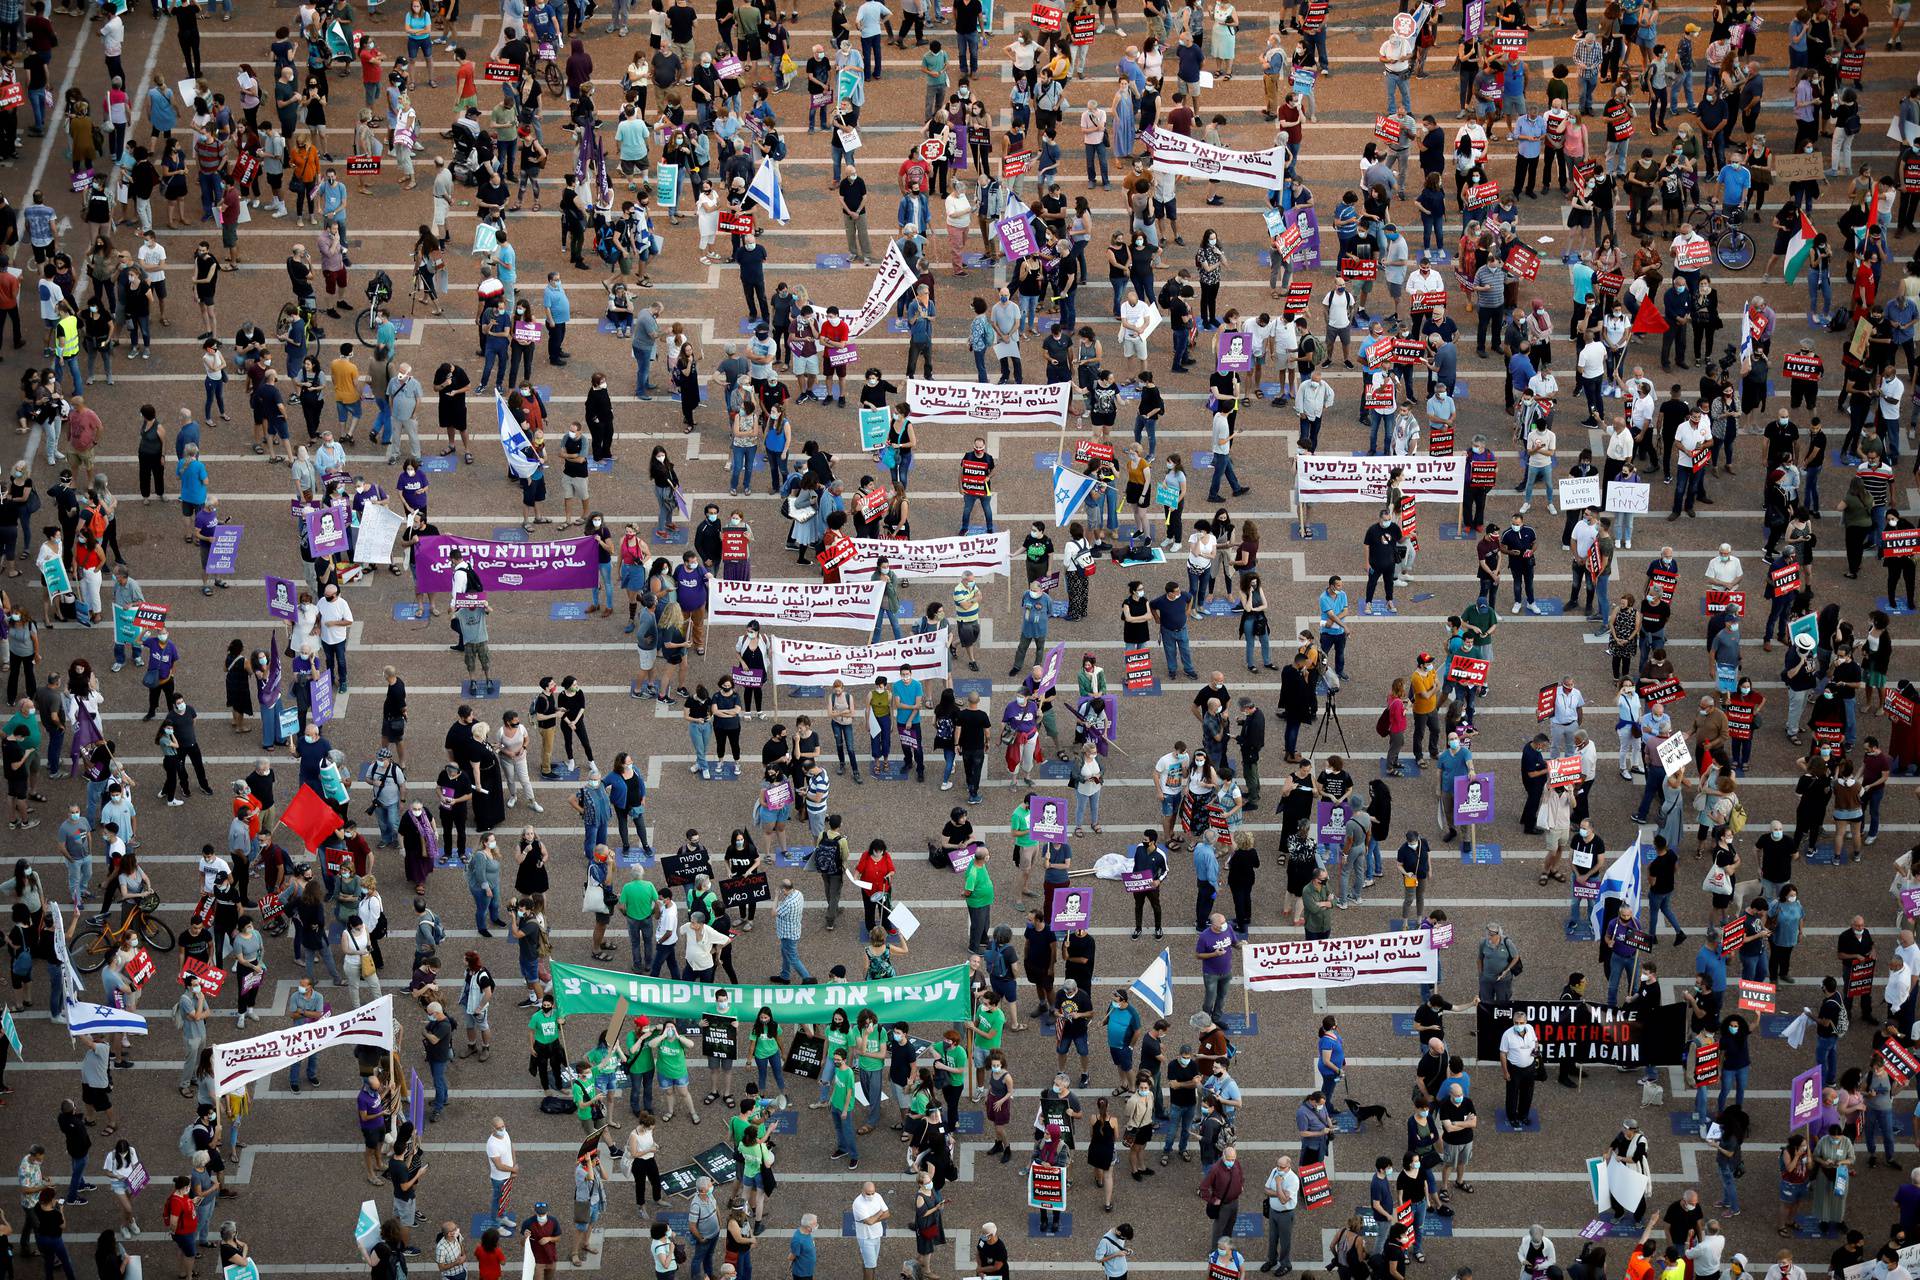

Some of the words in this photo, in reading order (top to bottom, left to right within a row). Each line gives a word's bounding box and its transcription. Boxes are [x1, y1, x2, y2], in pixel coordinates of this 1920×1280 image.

[1468, 194, 1498, 207] APARTHEID
[1679, 257, 1709, 266] APARTHEID
[1787, 356, 1819, 364] Palestinian
[1787, 364, 1816, 373] LIVES
[915, 384, 967, 398] פלסטין
[972, 387, 1018, 399] ישראל
[920, 397, 970, 408] فلسطين
[1304, 461, 1357, 473] פלסטין
[1416, 460, 1456, 473] שלום
[1560, 478, 1598, 486] PALESTINIAN
[864, 502, 889, 519] APARTHEID
[837, 540, 850, 550] לא
[904, 542, 954, 554] ישראל
[959, 538, 999, 551] שלום
[1887, 539, 1917, 548] LIVES
[495, 543, 525, 558] ולא
[532, 543, 576, 557] שלום
[552, 558, 586, 570] سلام
[824, 548, 854, 569] לסיפוח
[478, 560, 506, 570] ضم
[511, 561, 548, 570] وليس
[1776, 574, 1797, 586] LIVES
[724, 594, 778, 606] فلسطين
[783, 595, 833, 608] إسرائيل
[837, 596, 870, 606] سلام
[138, 611, 162, 620] LIVES
[788, 650, 841, 665] فلسطين
[846, 648, 896, 661] إسرائيل
[901, 646, 935, 658] سلام
[1473, 662, 1487, 670] לא
[1128, 671, 1151, 679] הכיבוש
[1451, 669, 1483, 680] לסיפוח
[1648, 686, 1677, 700] LIVES
[1550, 774, 1580, 784] APARTHEID
[679, 853, 702, 863] סיפוח
[753, 885, 767, 897] לא
[1318, 938, 1374, 951] ישראל
[1380, 935, 1424, 946] שלום
[1253, 942, 1312, 958] פלסטין
[1384, 949, 1420, 962] سلام
[1260, 954, 1319, 969] فلسطين
[1324, 951, 1379, 965] إسرائيل
[207, 970, 222, 980] לא
[562, 978, 616, 995] מרצ
[877, 980, 960, 1003] לעצור
[1742, 982, 1773, 991] Palestinian
[754, 985, 816, 1008] אסון
[825, 985, 868, 1005] את
[1743, 991, 1771, 1001] LIVES
[1527, 1006, 1577, 1023] DON'T
[1591, 1007, 1638, 1023] MAKE
[281, 1026, 334, 1047] ישראל
[1534, 1024, 1630, 1042] APARTHEID
[705, 1036, 734, 1046] הסיפוח
[798, 1050, 817, 1058] אסון
[1589, 1043, 1639, 1062] AGAIN
[792, 1054, 820, 1066] הסיפוח
[1882, 1047, 1911, 1075] LIVES
[1304, 1171, 1326, 1182] גזענות
